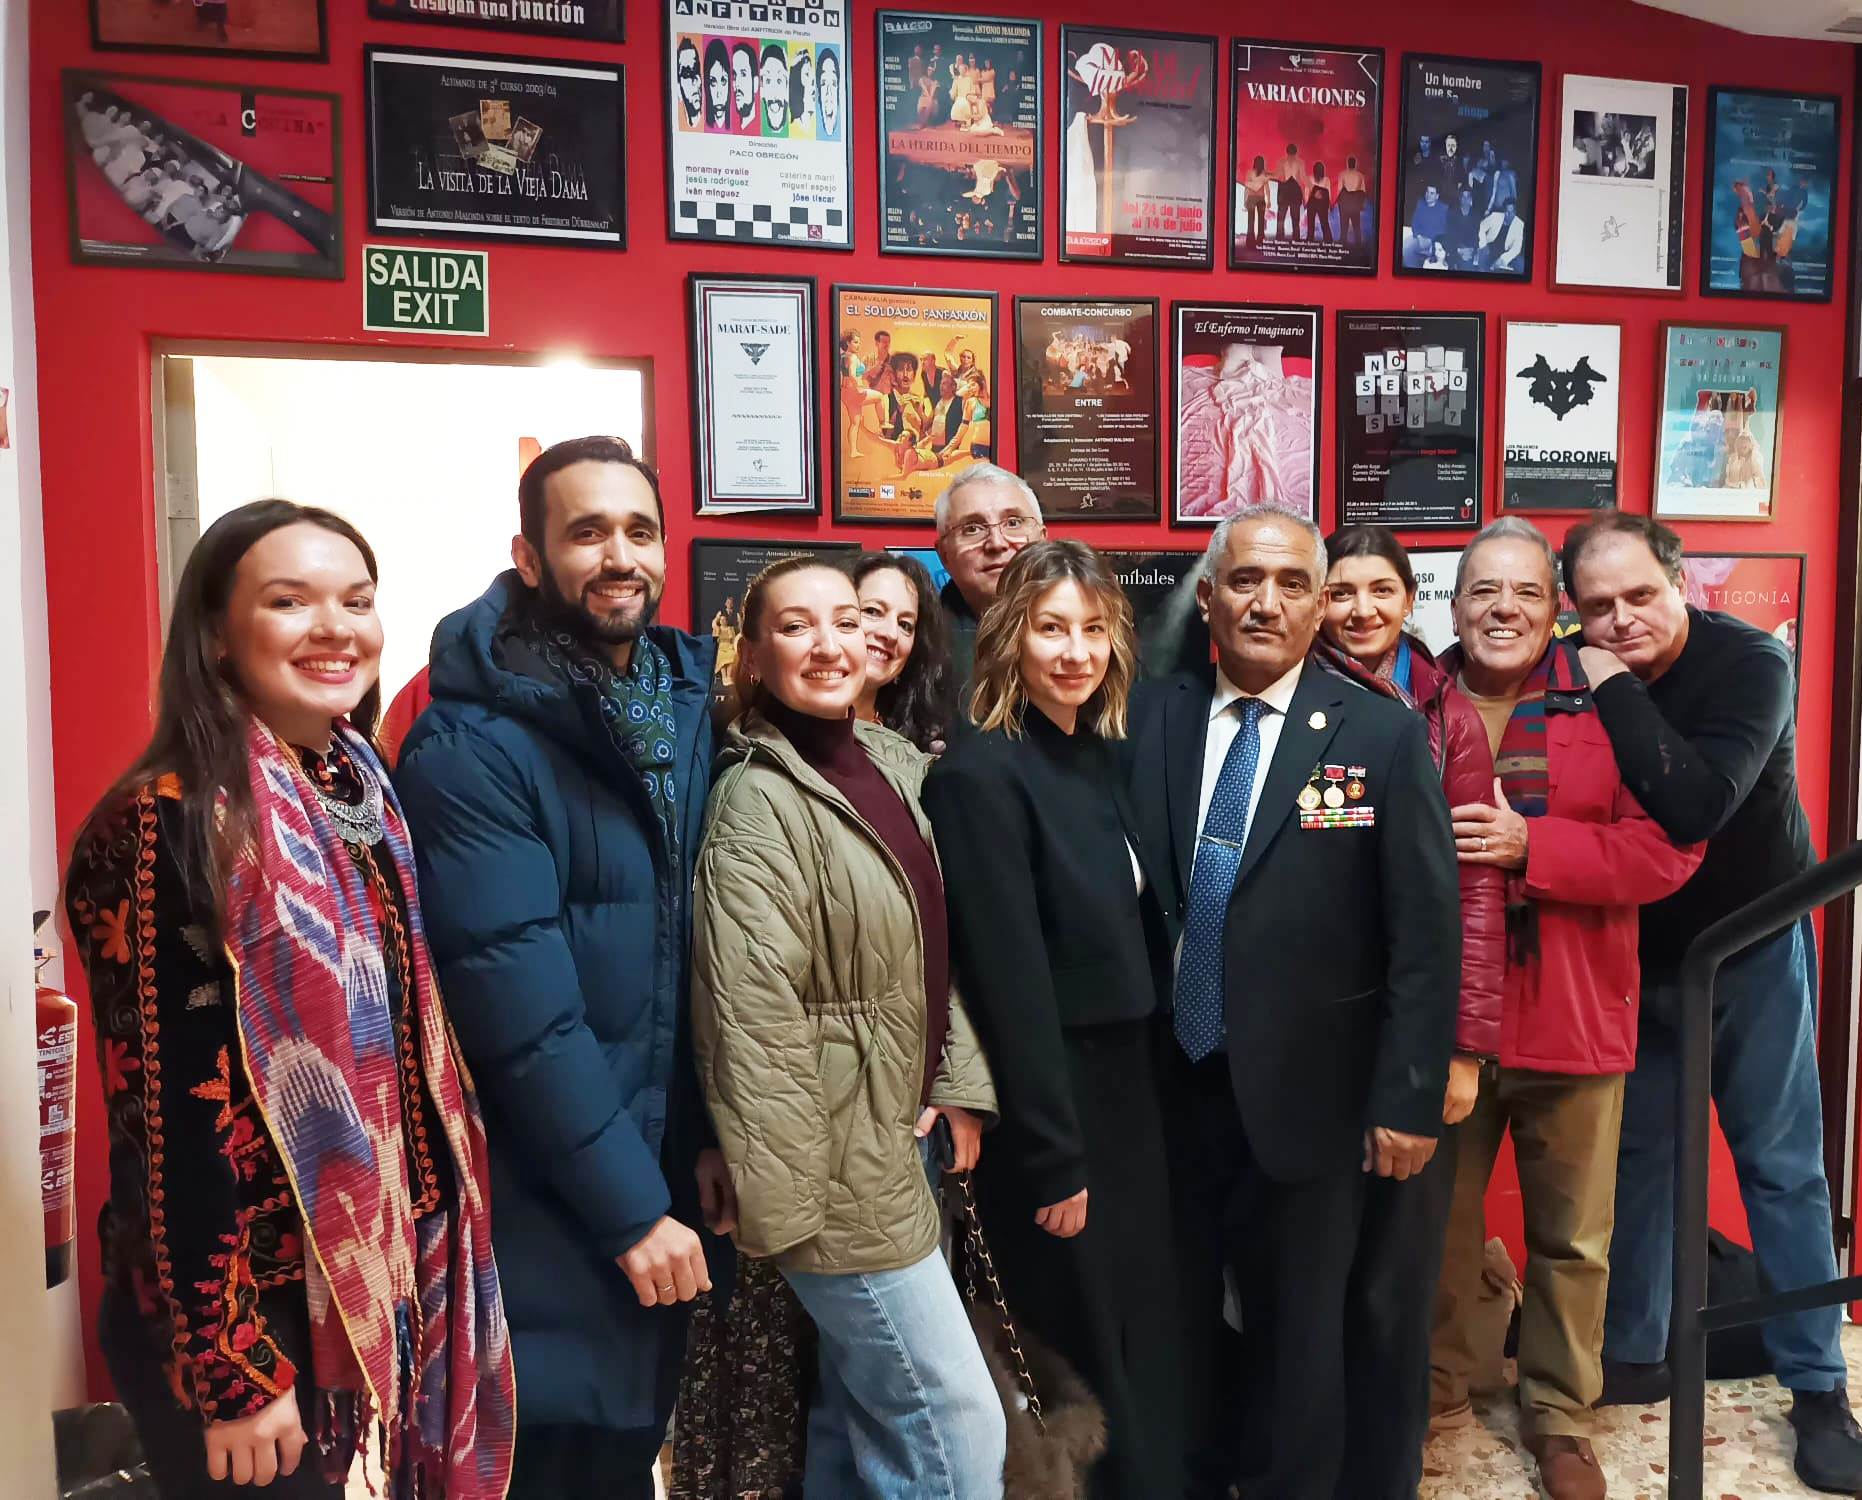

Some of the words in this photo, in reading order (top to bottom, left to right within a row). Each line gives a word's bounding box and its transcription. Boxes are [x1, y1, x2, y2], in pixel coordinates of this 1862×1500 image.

[511, 0, 585, 25] función
[676, 2, 839, 27] ANFITRION
[1425, 71, 1439, 85] Un
[1442, 73, 1482, 89] hombre
[1247, 82, 1366, 108] VARIACIONES
[729, 149, 754, 157] PACO
[908, 140, 955, 152] HERIDA
[959, 142, 981, 154] DEL
[983, 143, 1032, 156] TIEMPO
[1160, 203, 1173, 216] de
[1176, 204, 1203, 219] junio
[1132, 216, 1141, 228] al
[1163, 217, 1177, 230] de
[1179, 218, 1203, 233] julio
[369, 252, 482, 291] SALIDA
[393, 290, 460, 325] EXIT
[846, 304, 861, 315] EL
[864, 305, 919, 318] SOLDADO
[1041, 307, 1132, 317] COMBATE-CONCURSO
[1194, 321, 1210, 333] El
[1209, 321, 1250, 337] Enfermo
[1253, 324, 1304, 339] Imaginario
[1075, 399, 1103, 407] ENTRE
[1506, 449, 1533, 462] DEL
[1540, 450, 1615, 463] CORONEL
[1418, 590, 1431, 601] DE
[1687, 590, 1790, 605] ANTIGONIA
